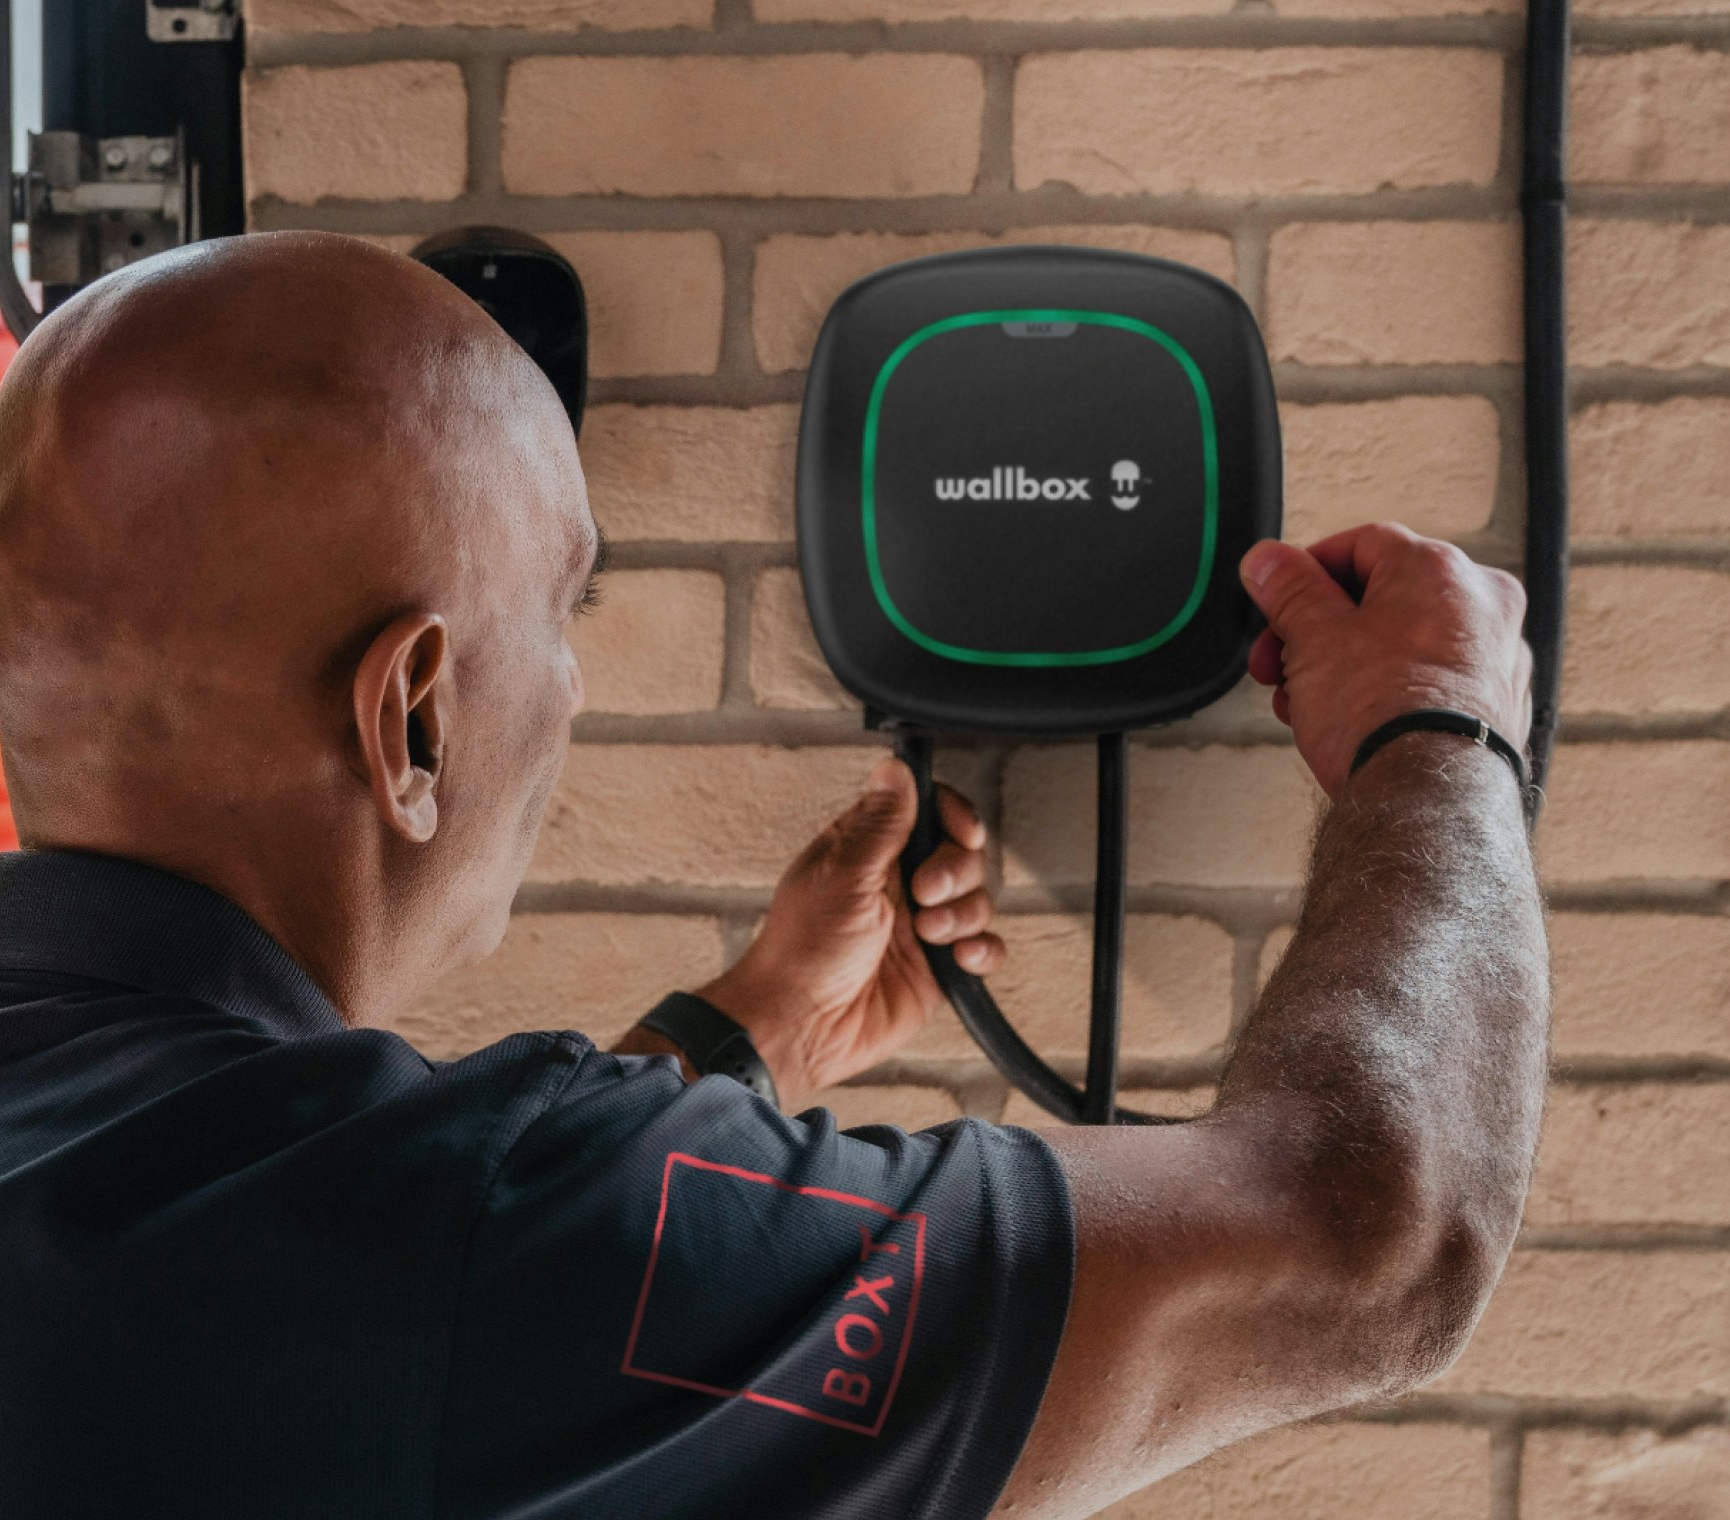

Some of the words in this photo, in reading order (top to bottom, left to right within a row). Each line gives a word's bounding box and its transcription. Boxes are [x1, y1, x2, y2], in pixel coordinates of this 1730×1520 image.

[1025, 321, 1054, 333] MAX
[935, 465, 1092, 501] wallbox
[822, 1223, 900, 1407] BOXT
